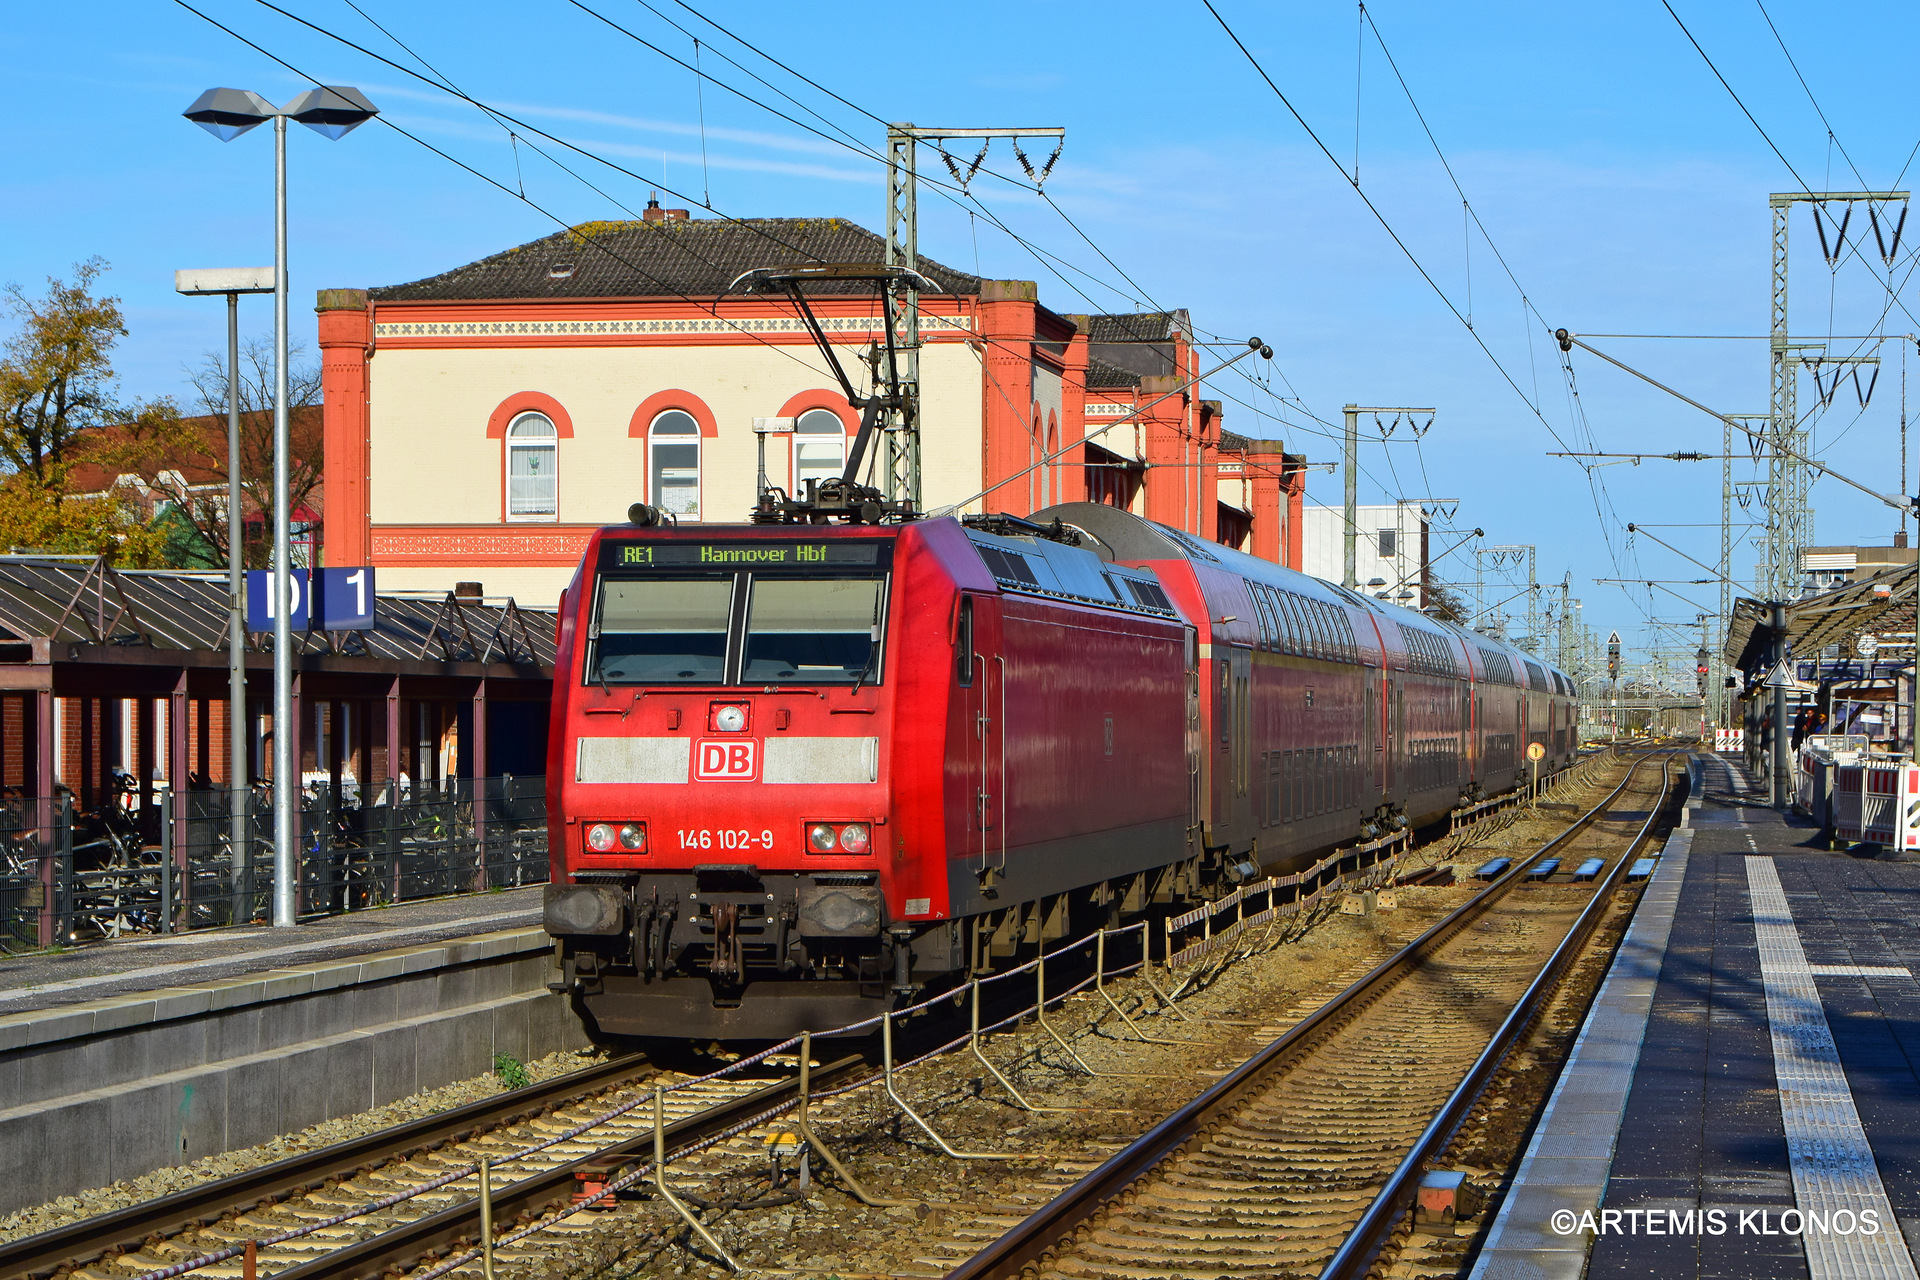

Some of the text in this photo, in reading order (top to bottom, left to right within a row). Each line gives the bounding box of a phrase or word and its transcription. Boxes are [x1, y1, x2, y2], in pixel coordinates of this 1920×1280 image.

[624, 545, 827, 563] RE1 Hannover Hbf
[346, 569, 366, 616] 1
[703, 744, 750, 774] DB
[677, 829, 774, 849] 146 102-9
